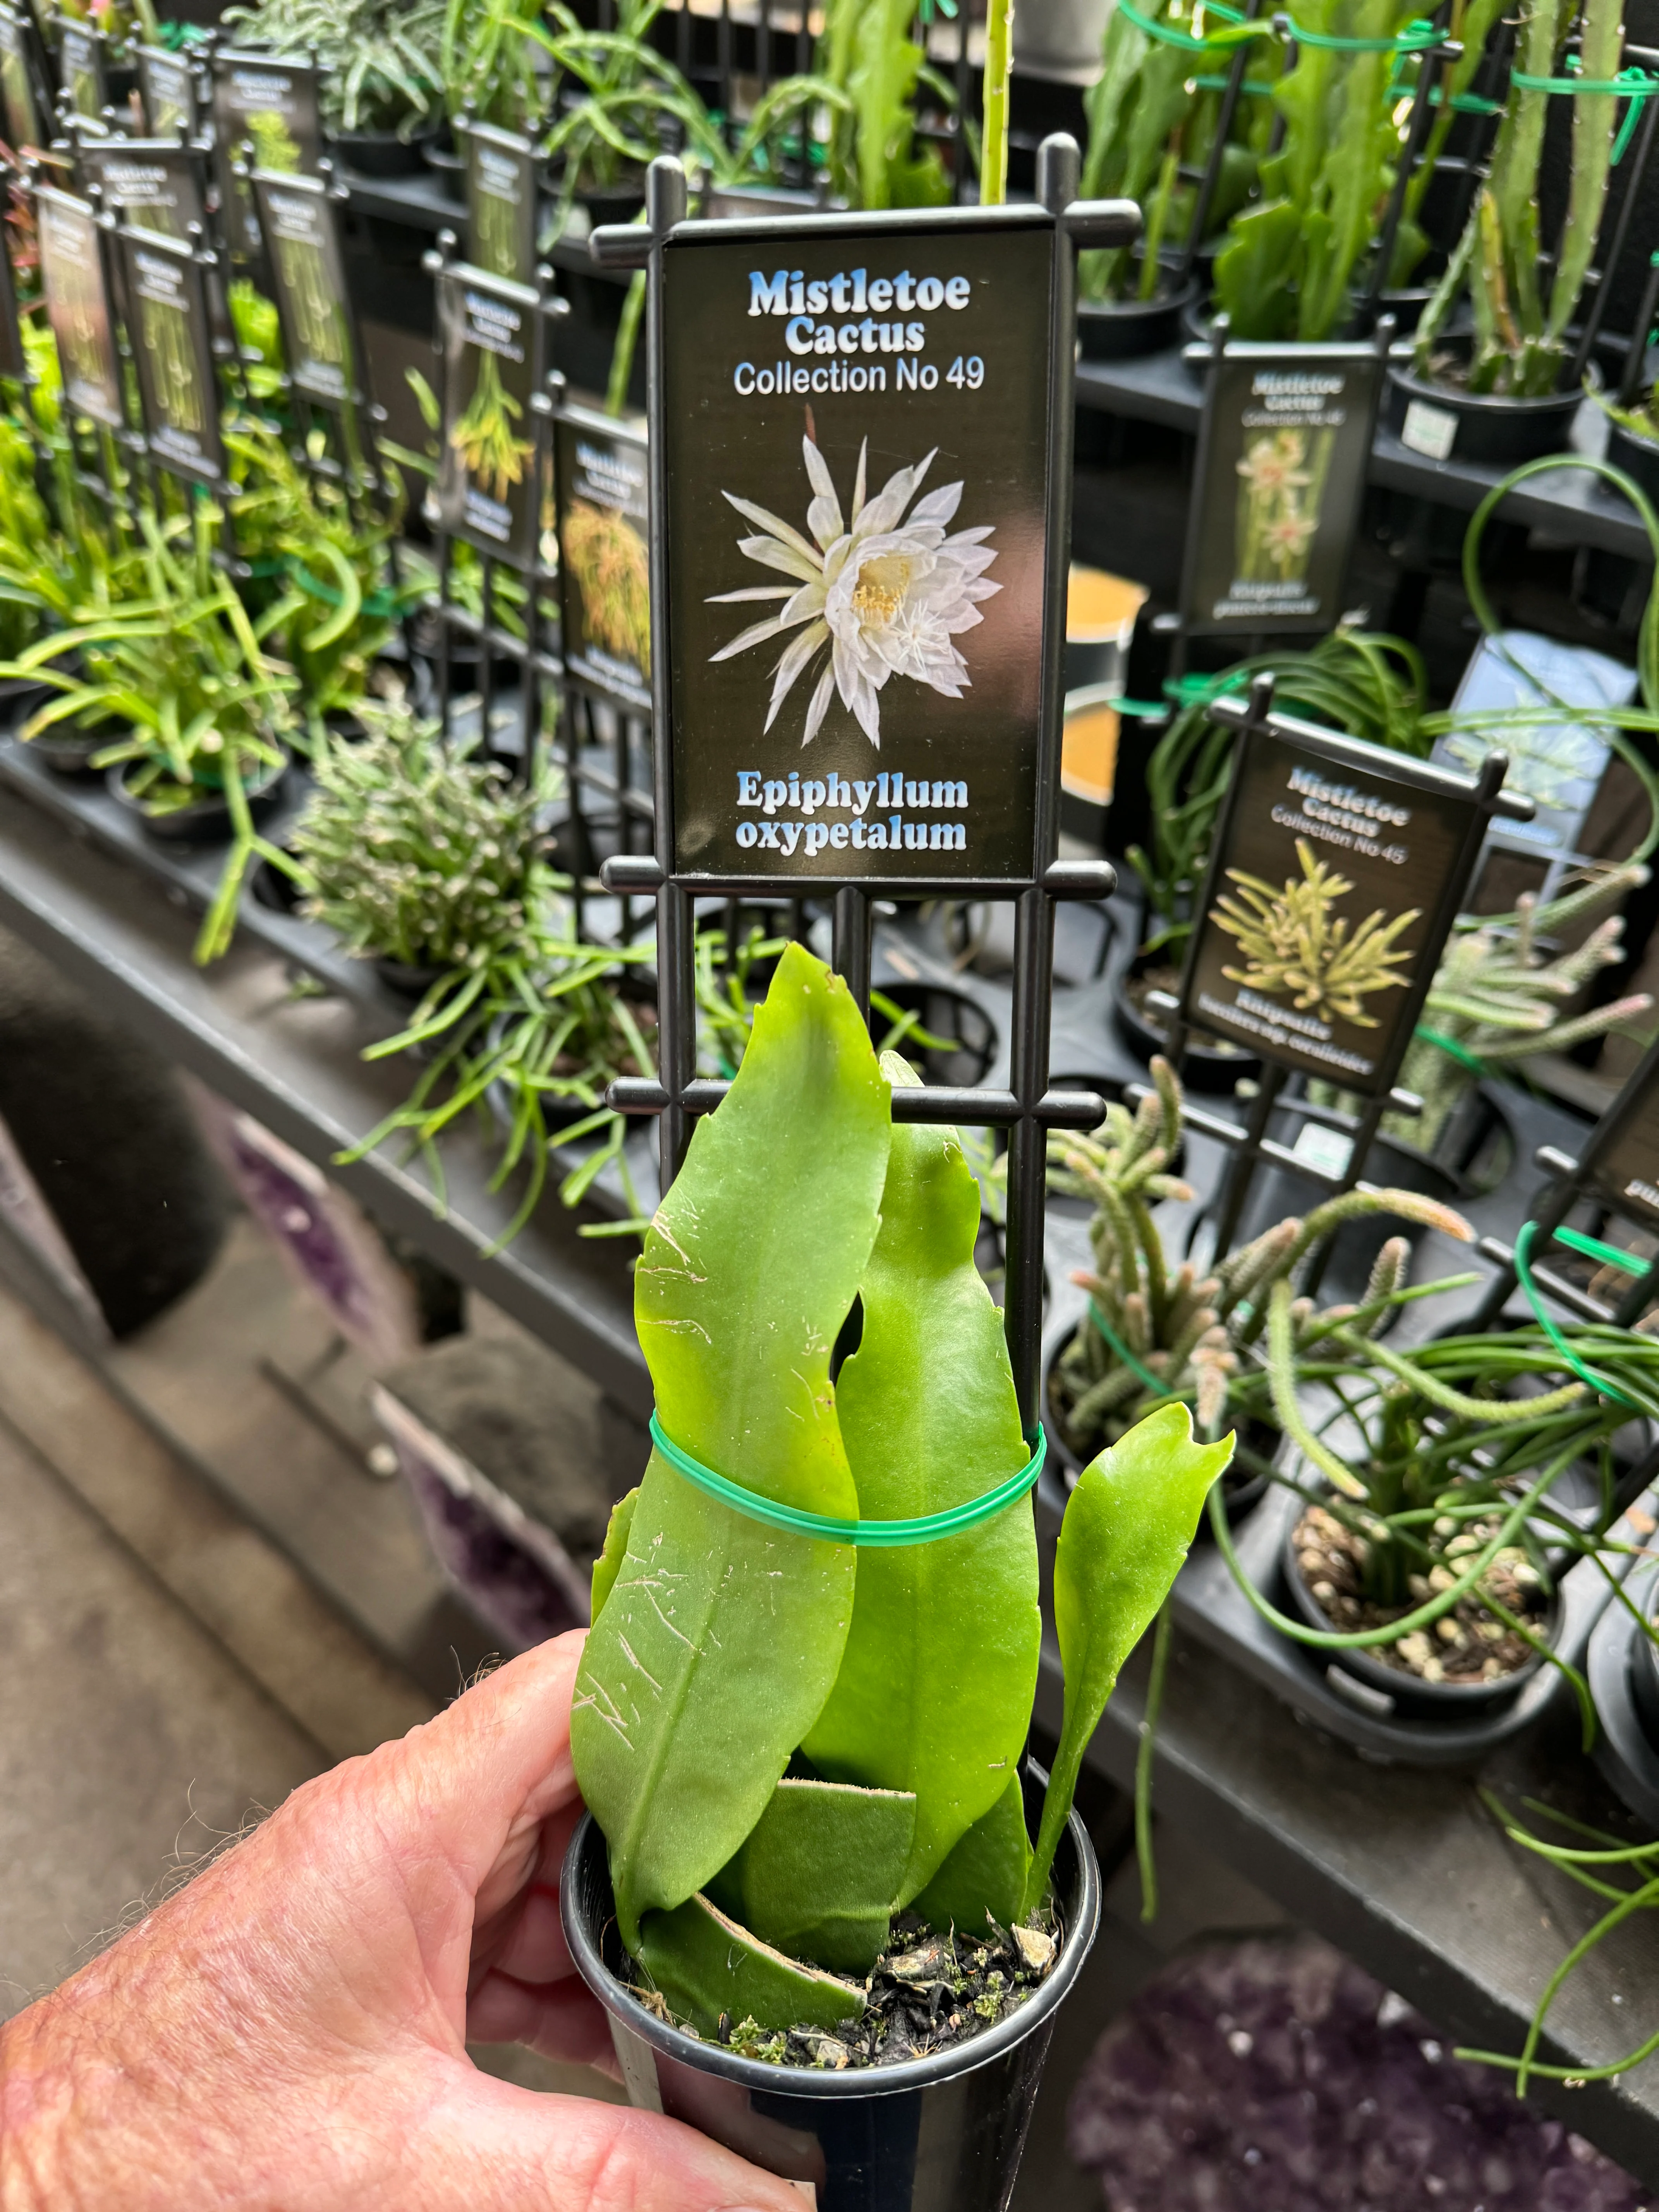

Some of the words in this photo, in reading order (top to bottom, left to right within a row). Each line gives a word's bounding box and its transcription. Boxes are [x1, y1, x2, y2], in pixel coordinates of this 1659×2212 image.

[748, 268, 970, 316] Mistletoe
[785, 315, 926, 355] Cactus
[733, 360, 886, 395] Collection
[896, 357, 939, 391] No
[945, 356, 985, 390] 49
[737, 771, 968, 815] Epiphyllum
[1286, 766, 1410, 826] Mistletoe
[735, 814, 966, 857] oxypetalum
[1271, 803, 1354, 848] Collection
[1353, 836, 1382, 857] No
[1302, 797, 1381, 837] Cactus
